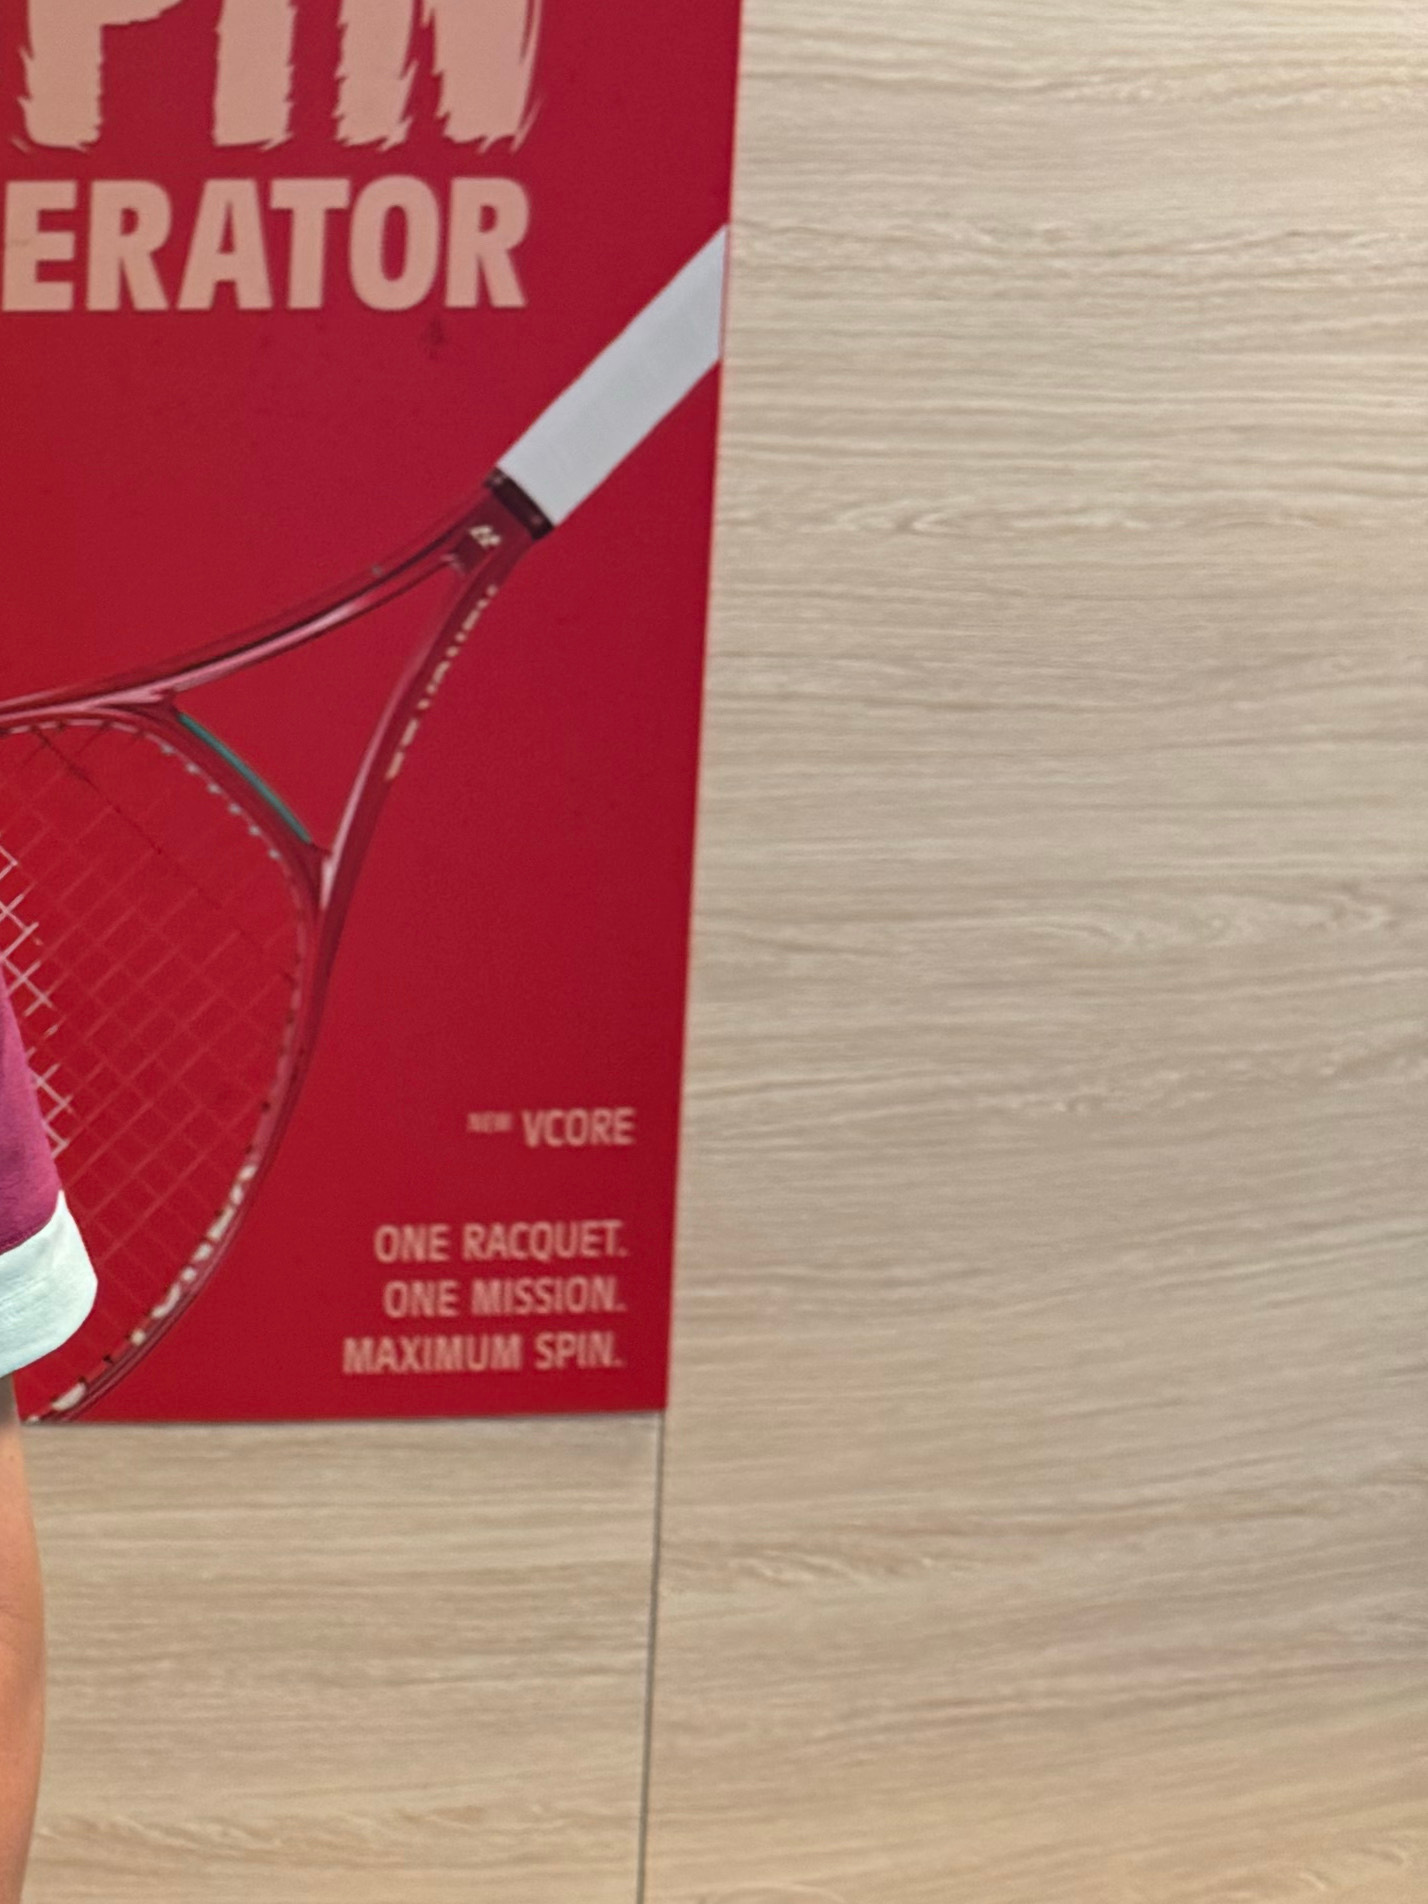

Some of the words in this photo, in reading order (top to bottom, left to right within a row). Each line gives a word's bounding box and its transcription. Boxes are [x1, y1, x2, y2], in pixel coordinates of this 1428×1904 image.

[522, 1107, 637, 1148] VCORE
[374, 1224, 451, 1263] ONE
[462, 1219, 630, 1264] RACQUET.
[383, 1279, 460, 1319] ONE
[470, 1274, 628, 1317] MISSION.
[342, 1333, 523, 1375] MAXIMUM
[534, 1330, 626, 1371] SPIN.
